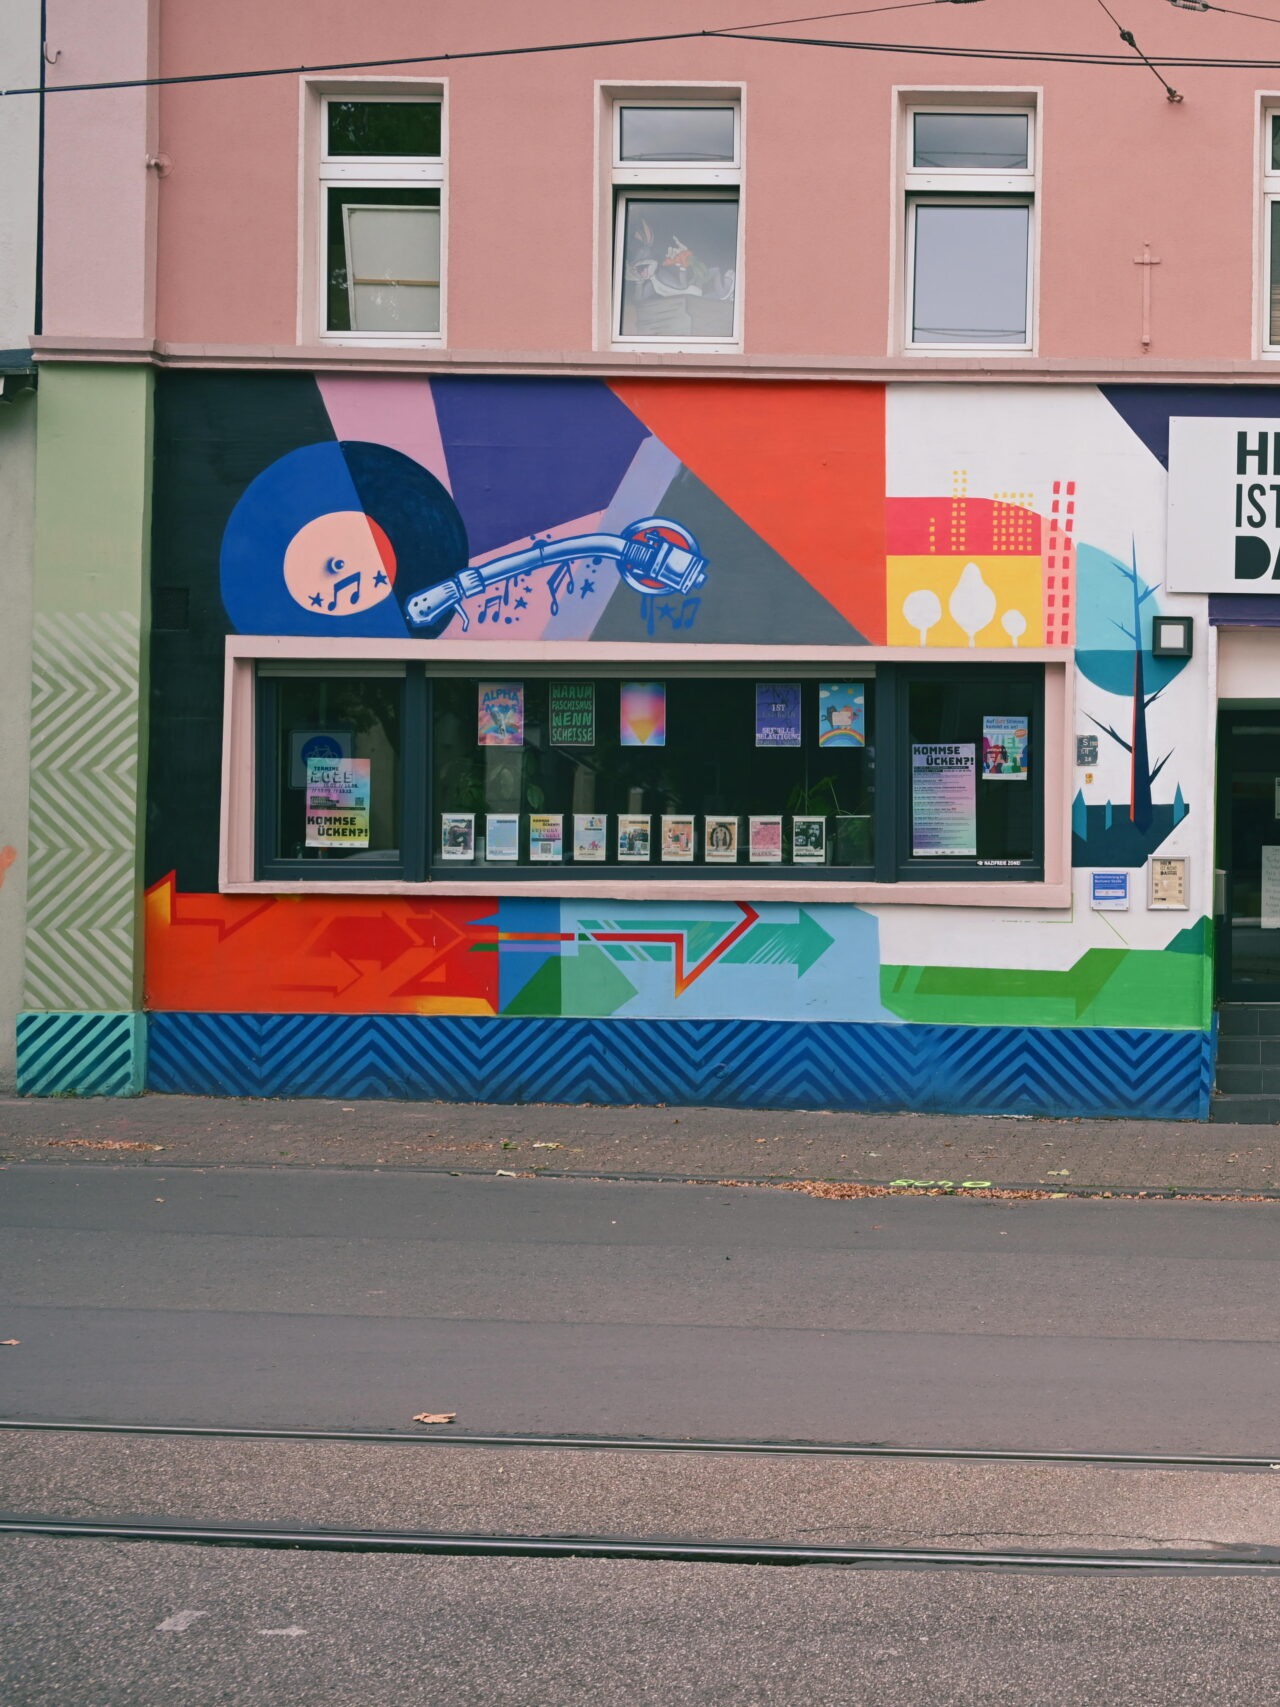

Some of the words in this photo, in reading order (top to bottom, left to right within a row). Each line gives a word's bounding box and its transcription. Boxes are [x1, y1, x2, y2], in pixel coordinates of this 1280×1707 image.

[483, 688, 520, 703] ALPHA
[552, 685, 592, 698] WARUM
[552, 700, 592, 710] FASCHISMUS
[552, 712, 592, 725] WENN
[552, 727, 592, 742] SCHEISSE
[914, 746, 960, 755] KOMMSE
[926, 755, 974, 765] ÜCKEN?!
[307, 816, 356, 826] KOMMSE
[318, 826, 369, 837] ÜCKEN?!
